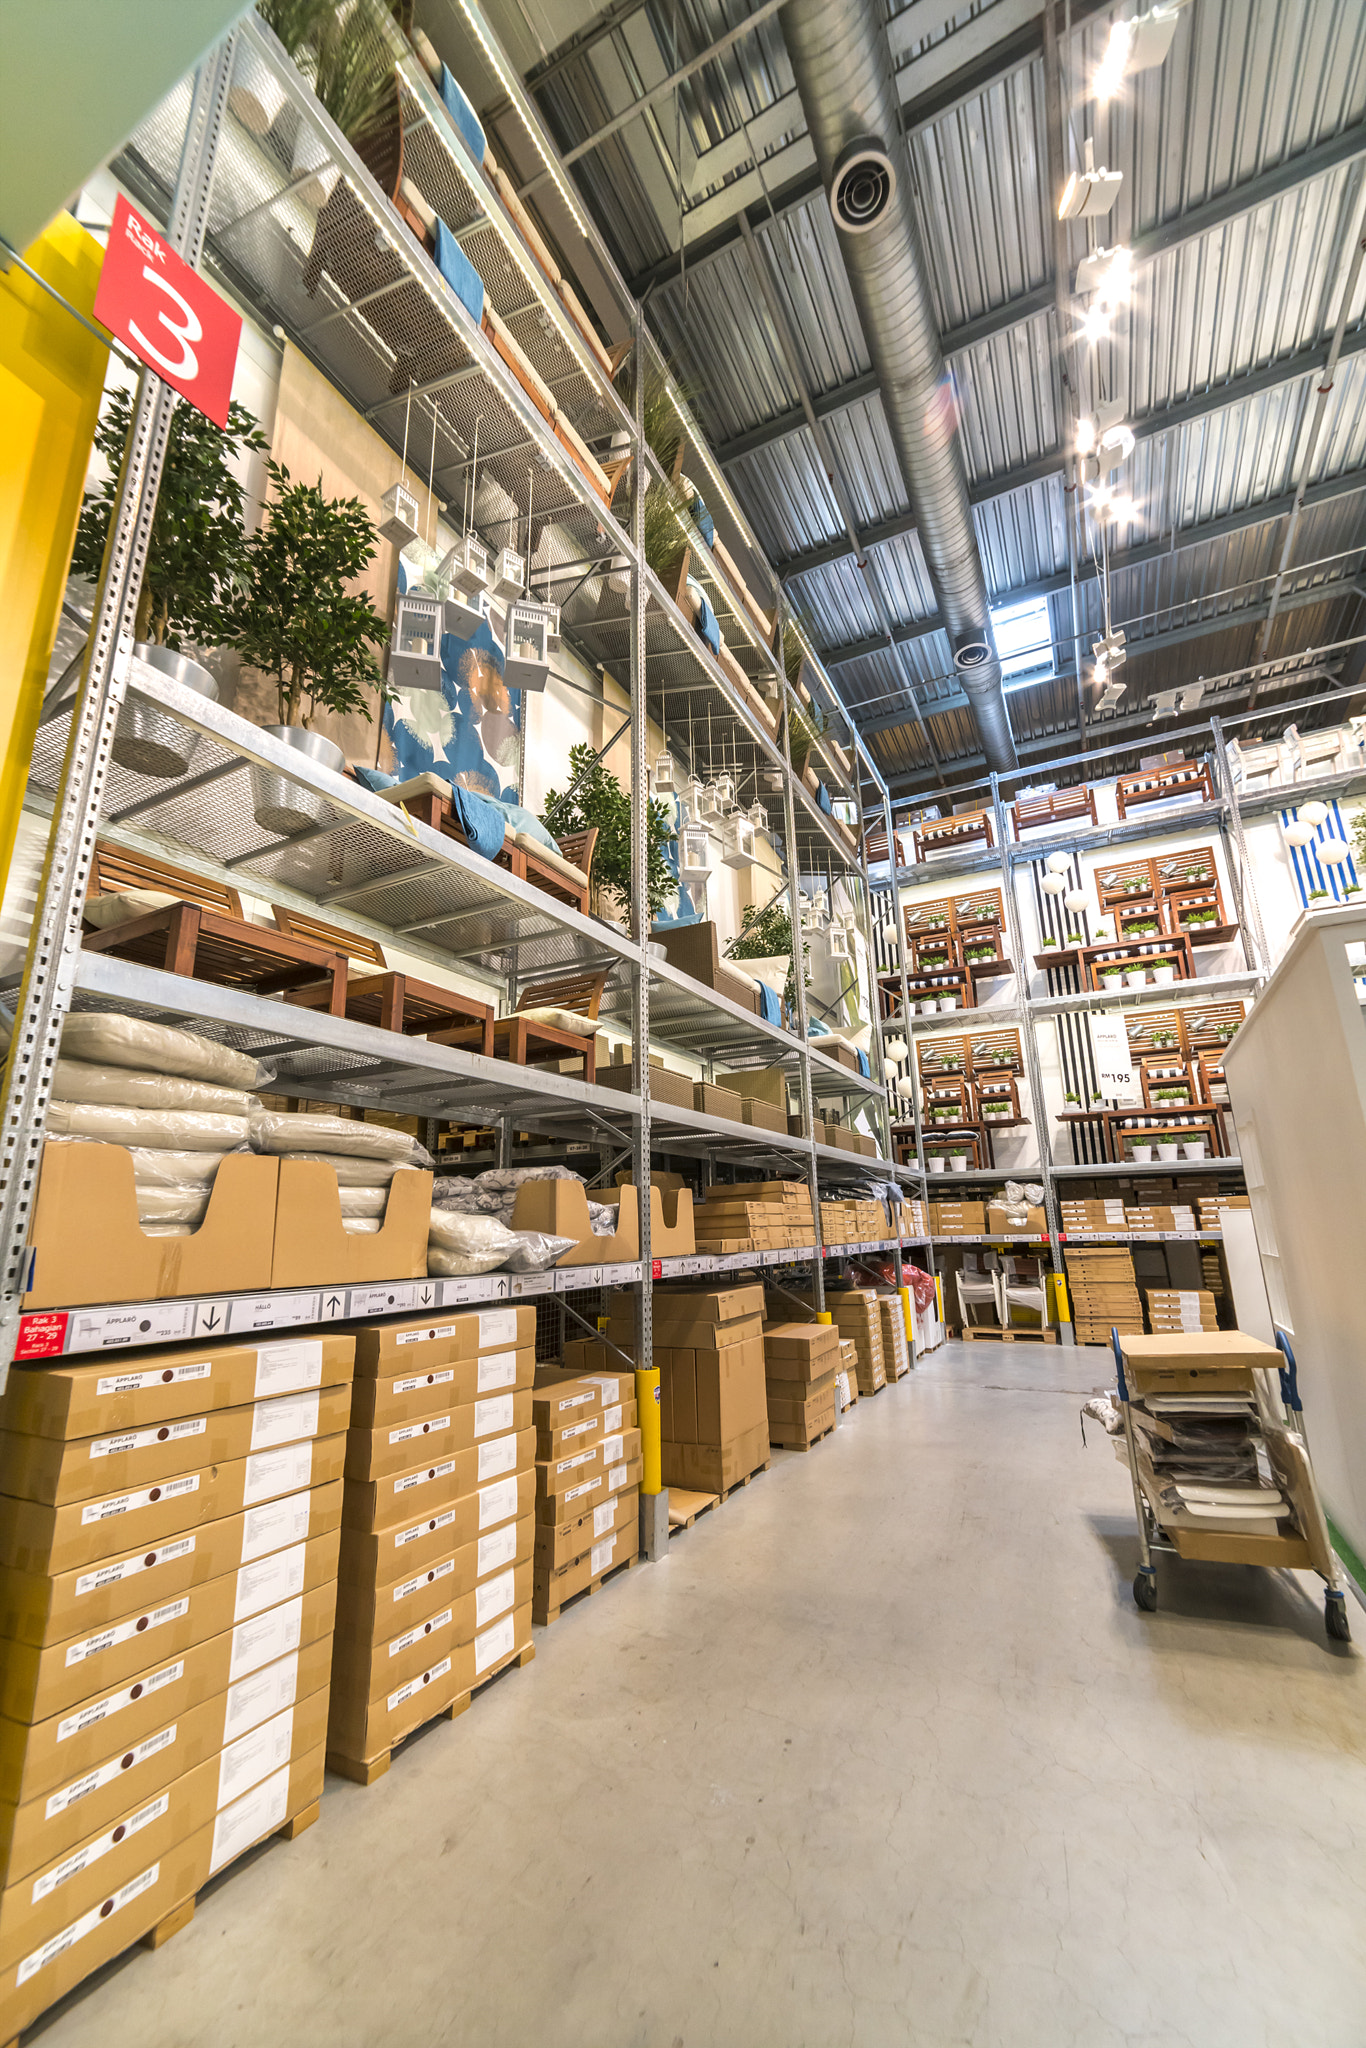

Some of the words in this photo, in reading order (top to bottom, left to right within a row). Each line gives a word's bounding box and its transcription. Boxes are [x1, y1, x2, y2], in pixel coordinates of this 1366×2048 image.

[127, 213, 166, 265] Rak
[128, 264, 203, 380] 3
[1111, 1073, 1130, 1083] 195
[32, 1317, 48, 1325] Rak
[24, 1324, 62, 1334] Bahagian
[26, 1333, 38, 1342] 27
[46, 1331, 57, 1340] 29
